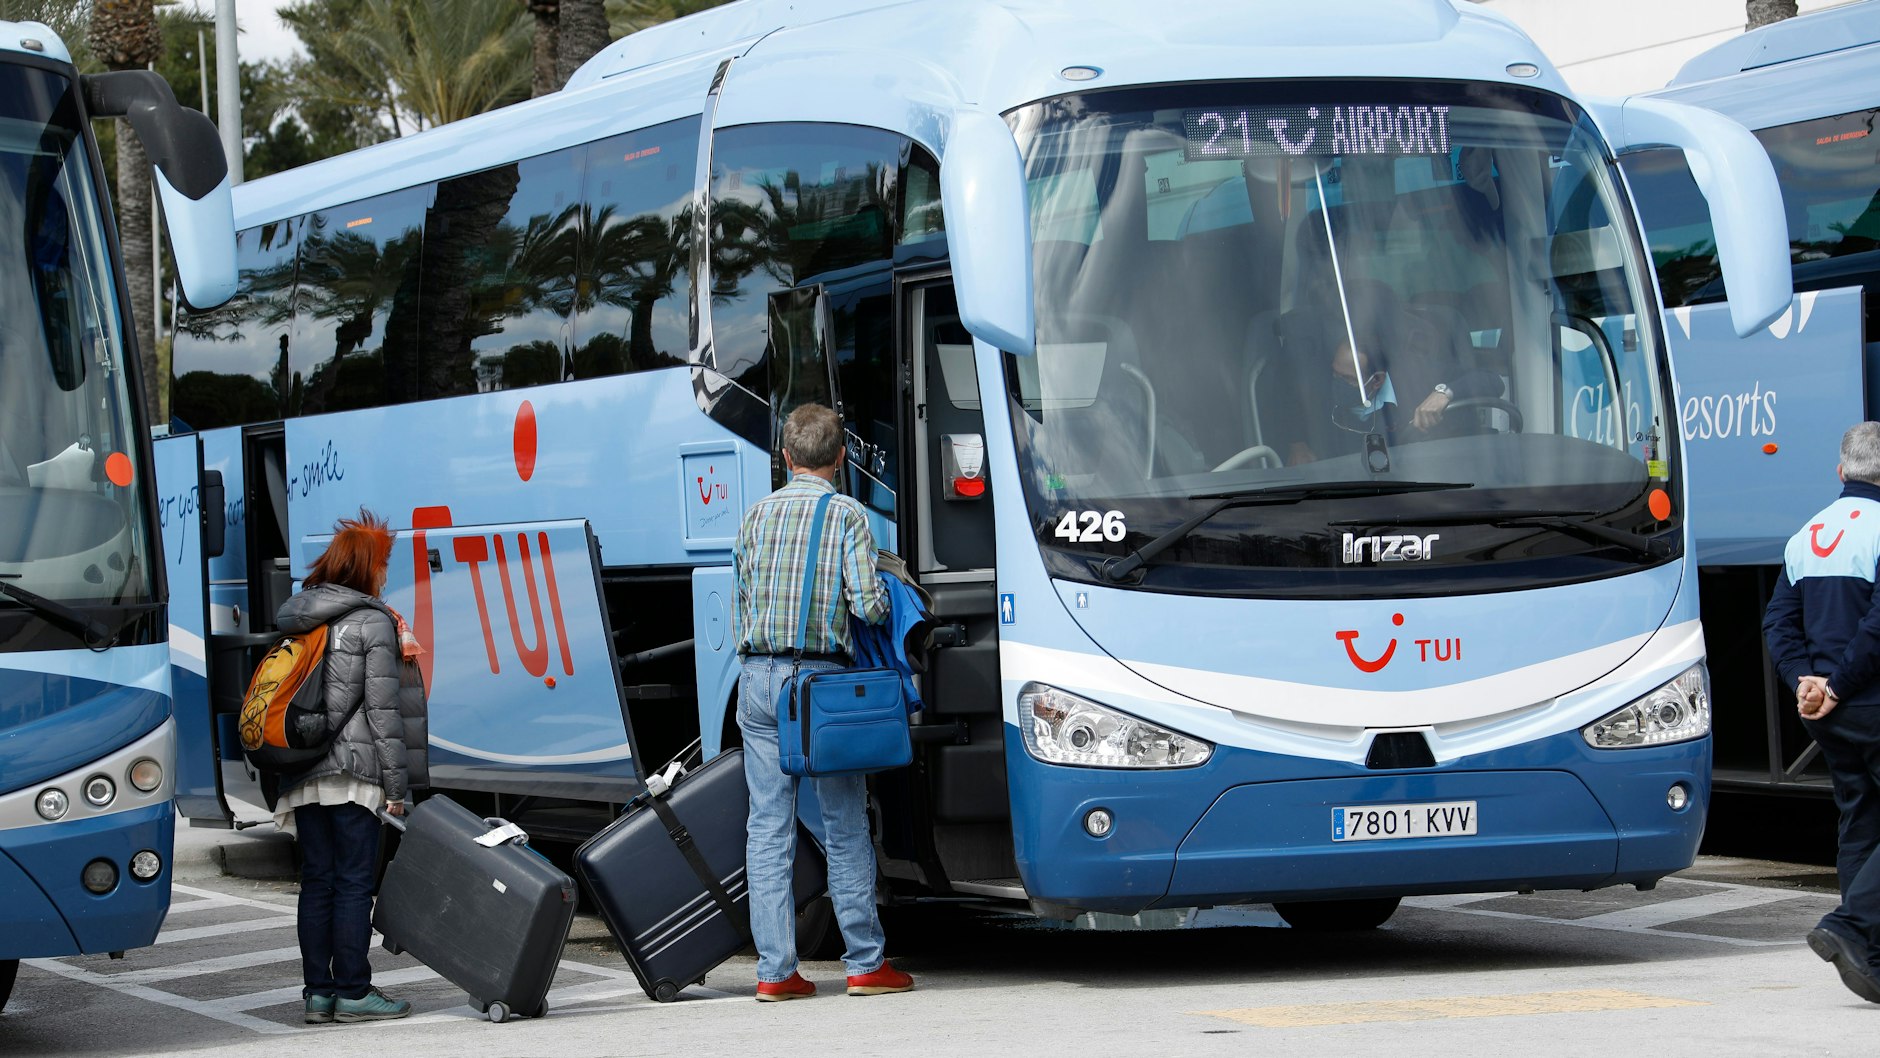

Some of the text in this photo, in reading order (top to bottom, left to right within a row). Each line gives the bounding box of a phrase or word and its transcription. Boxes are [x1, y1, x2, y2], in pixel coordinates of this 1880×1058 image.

[1198, 106, 1449, 154] 21 AIRPORT
[1677, 379, 1777, 441] esorts
[302, 439, 345, 498] smile
[716, 483, 728, 500] TUI
[1055, 510, 1127, 543] 426
[1342, 532, 1440, 564] Irizar
[453, 531, 575, 678] TUI
[1414, 638, 1461, 662] TUI
[1335, 806, 1471, 837] E 7801 KVV
